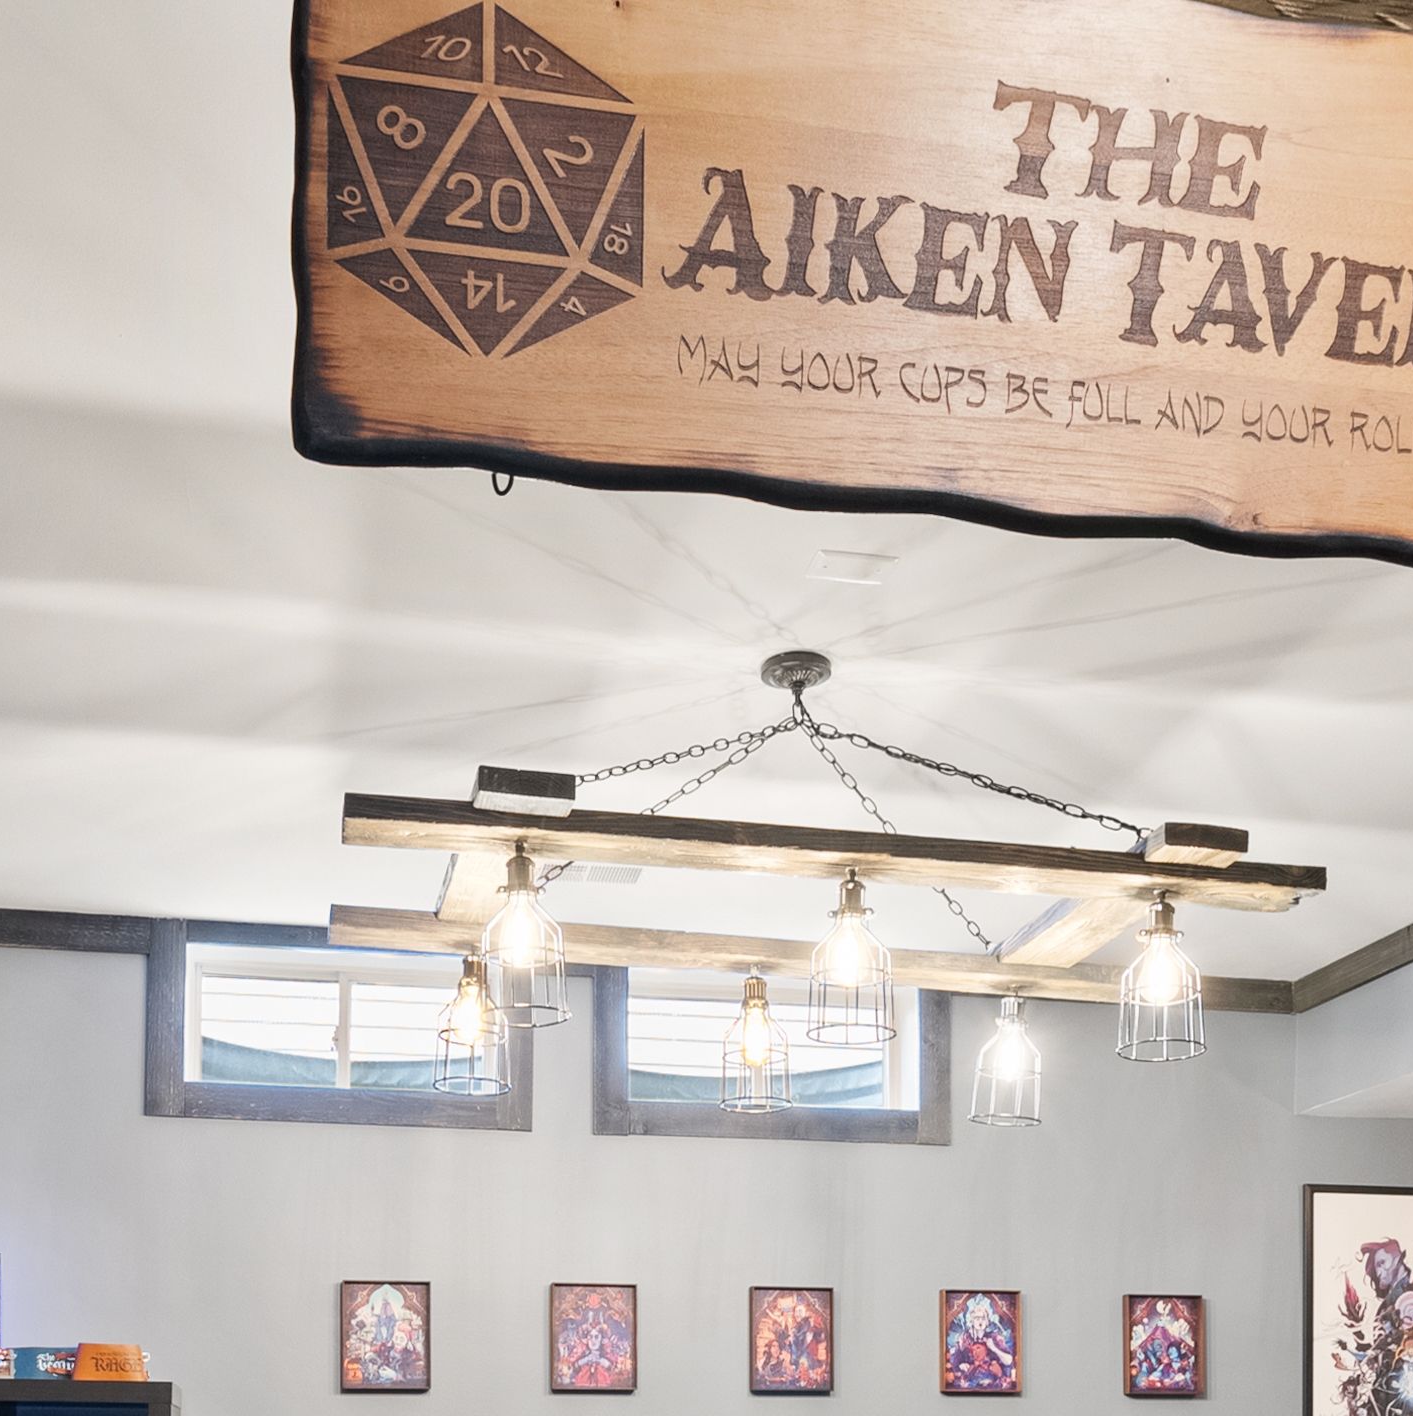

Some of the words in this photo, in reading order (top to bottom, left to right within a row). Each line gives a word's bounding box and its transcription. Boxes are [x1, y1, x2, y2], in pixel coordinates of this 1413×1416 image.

[420, 35, 472, 61] 10
[503, 45, 563, 78] 12
[376, 105, 426, 150] 8
[543, 135, 594, 178] 2
[993, 80, 1267, 220] THE
[445, 172, 530, 233] 20
[604, 222, 633, 256] 18
[661, 167, 1079, 323] AIKEN
[461, 270, 516, 313] 14
[560, 296, 587, 316] 4
[677, 334, 760, 388] MAY
[781, 347, 882, 397] YOUR
[899, 362, 988, 414] CUPS
[1005, 371, 1053, 417] BE
[1066, 382, 1142, 428] FULL
[1155, 390, 1225, 437] AND
[1241, 398, 1334, 448] YOUR
